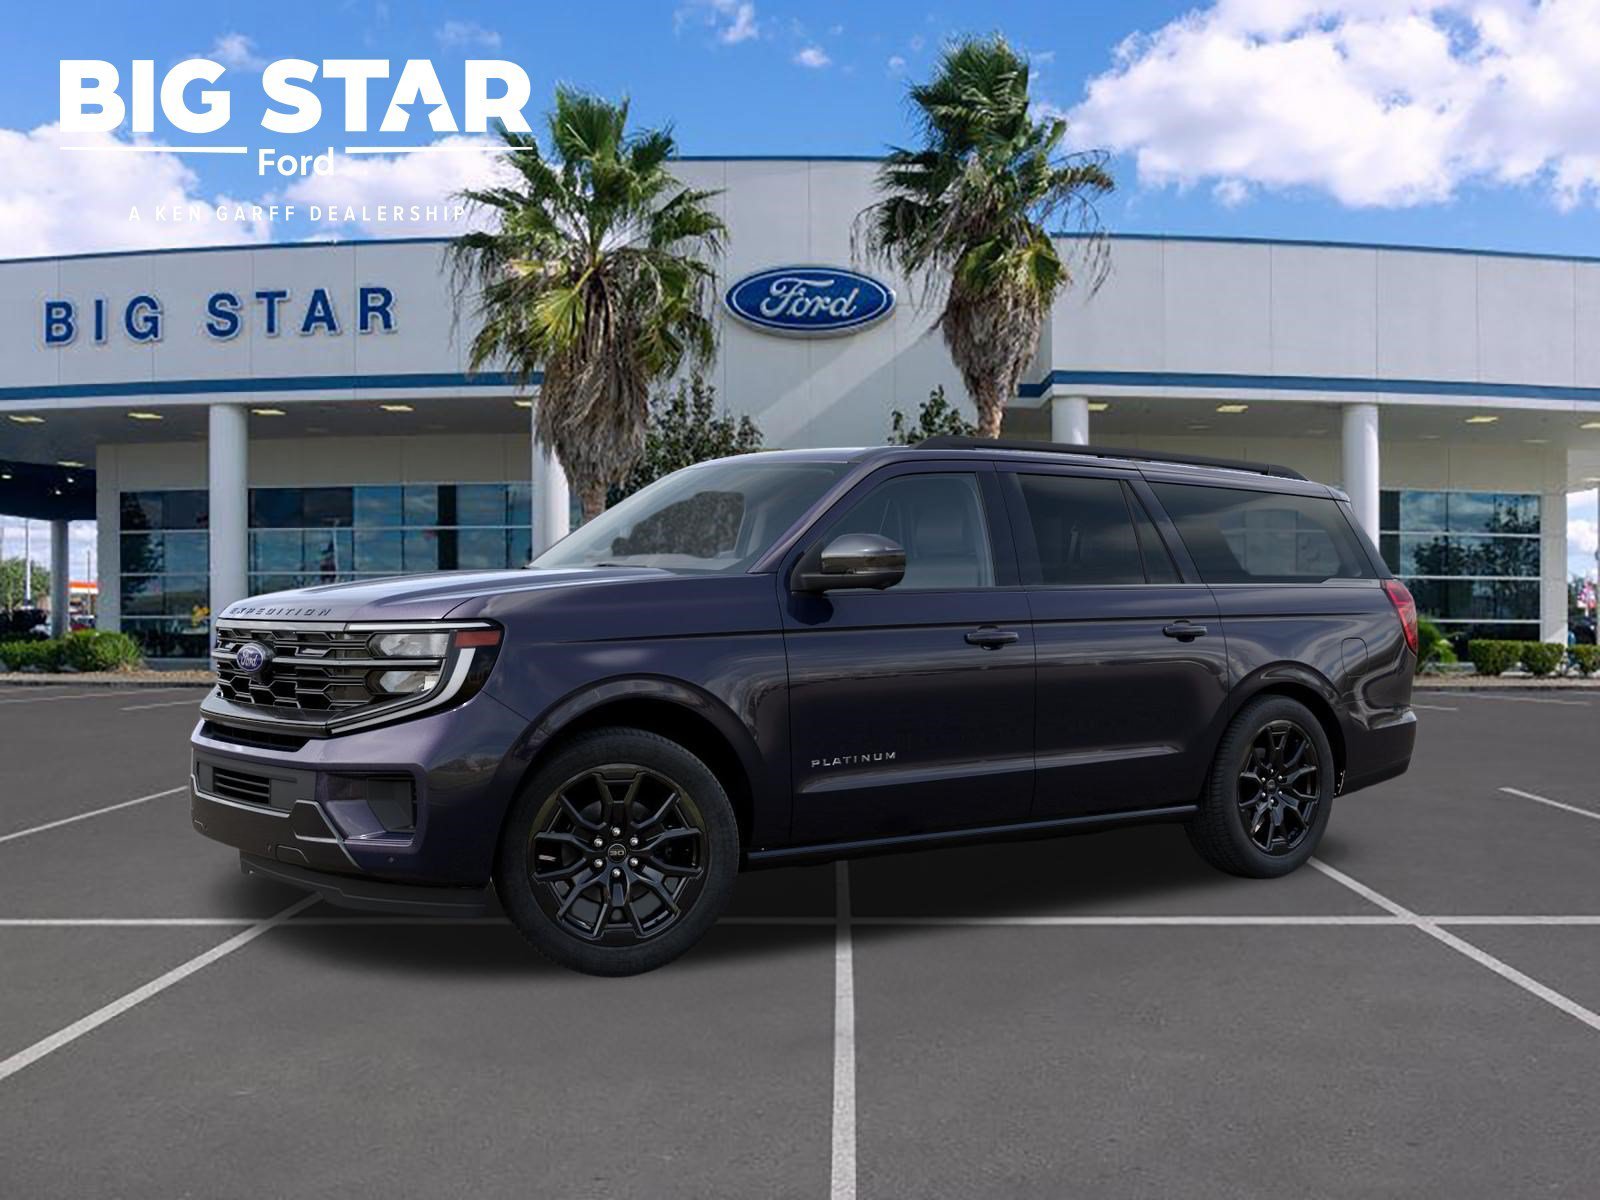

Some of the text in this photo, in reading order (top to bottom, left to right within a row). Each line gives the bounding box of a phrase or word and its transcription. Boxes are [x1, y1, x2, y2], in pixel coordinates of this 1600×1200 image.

[759, 277, 859, 318] Ford
[45, 286, 398, 345] BIG STAR
[230, 608, 331, 617] EXPEDITION
[239, 648, 259, 667] Ford
[811, 752, 896, 767] PLATINUM
